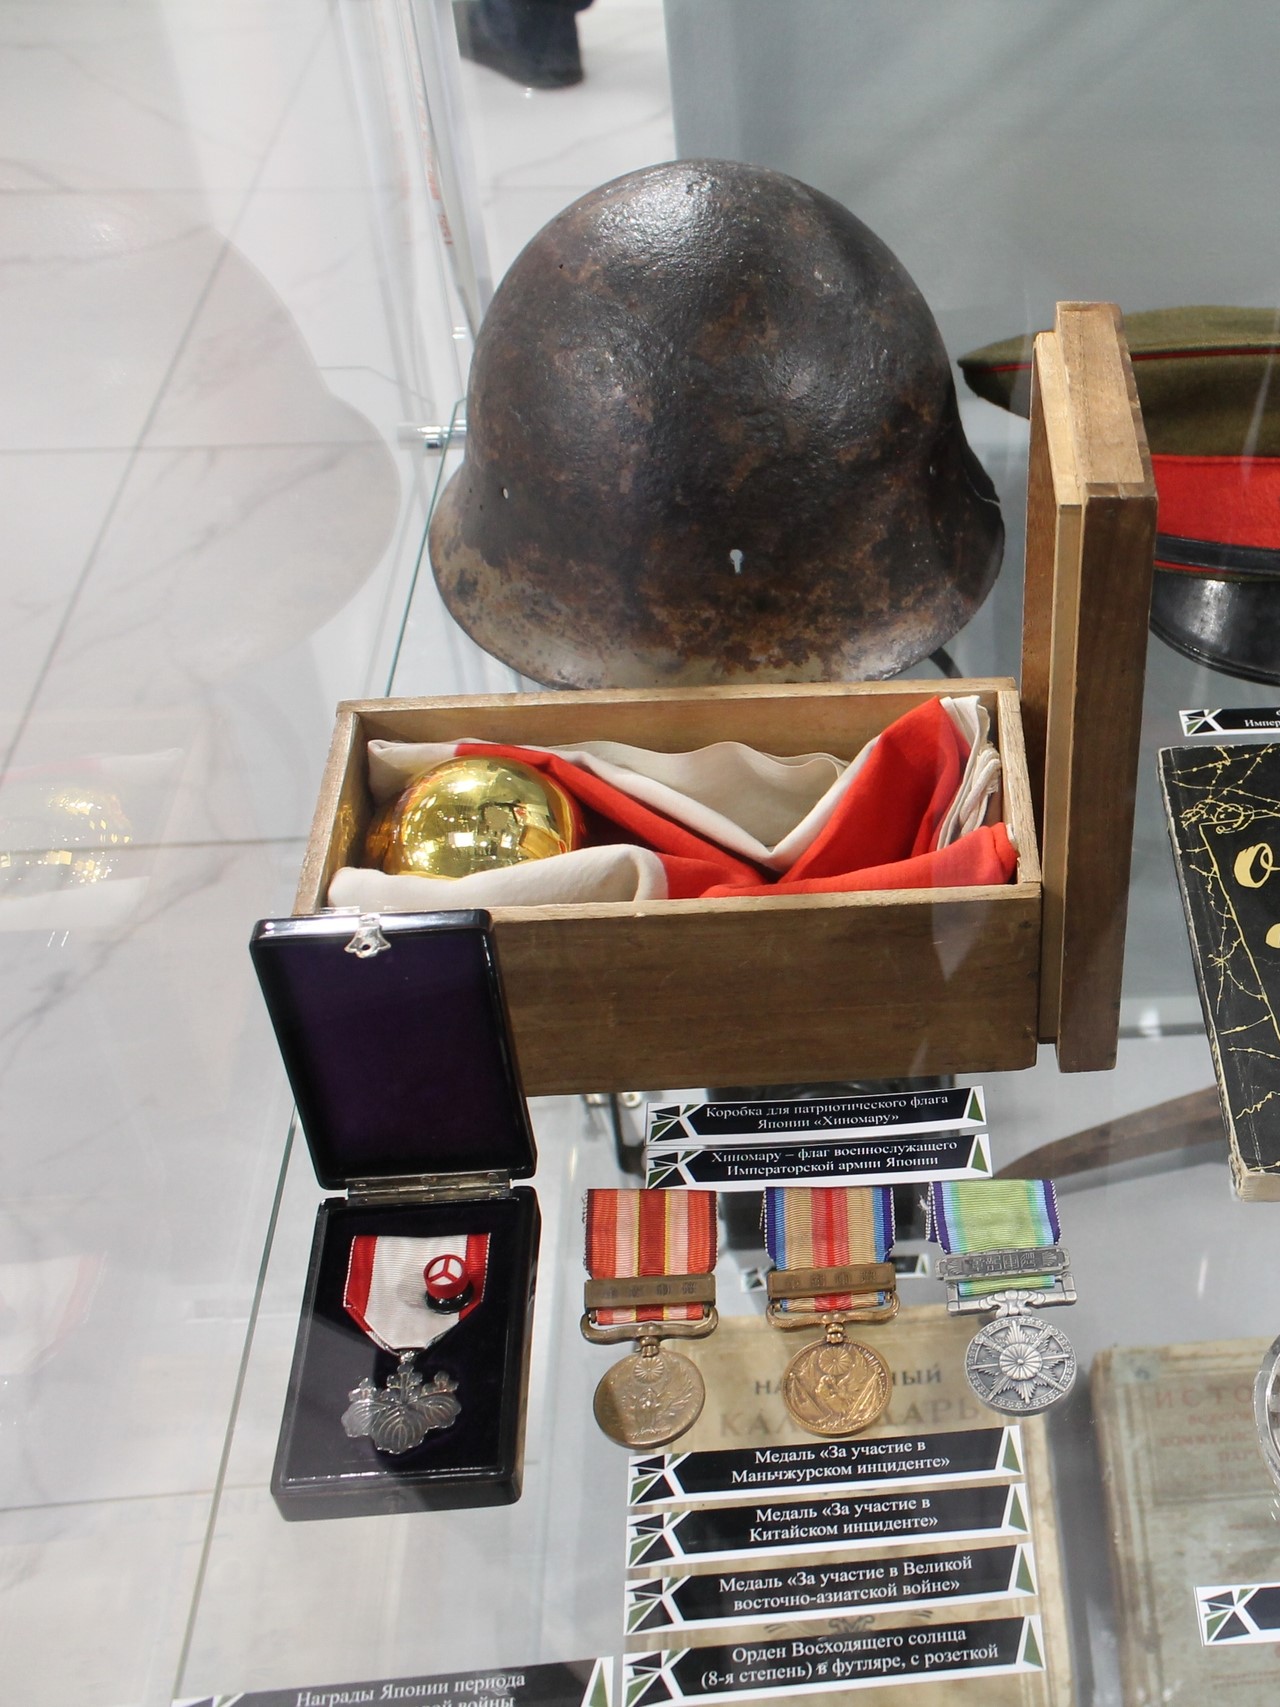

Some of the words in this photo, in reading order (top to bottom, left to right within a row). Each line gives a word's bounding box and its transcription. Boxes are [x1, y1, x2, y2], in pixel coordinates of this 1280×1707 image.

[706, 1105, 764, 1119] Коробка
[766, 1105, 790, 1117] для
[793, 1099, 906, 1116] патриотического
[909, 1095, 949, 1109] флага
[757, 1117, 810, 1129] Японии
[813, 1113, 900, 1129] «Хиномару»
[711, 1150, 782, 1165] Хиномару
[797, 1147, 831, 1161] флаг
[834, 1139, 958, 1157] военнослужащего
[726, 1160, 835, 1177] Императорской
[838, 1159, 882, 1172] армии
[885, 1155, 939, 1168] Японии
[755, 1448, 815, 1465] Медаль
[819, 1445, 848, 1460] «За
[850, 1443, 914, 1459] участие
[917, 1443, 926, 1452] в
[731, 1464, 853, 1485] Маньчжурском
[857, 1455, 951, 1476] инциденте»
[756, 1506, 818, 1523] Медаль
[822, 1503, 851, 1518] «За
[853, 1499, 917, 1516] участие
[921, 1498, 931, 1508] в
[749, 1524, 838, 1543] Китайском
[842, 1513, 938, 1535] инциденте»
[719, 1575, 783, 1593] Медаль
[787, 1571, 816, 1587] «За
[820, 1568, 885, 1586] участие
[889, 1567, 899, 1577] в
[903, 1556, 973, 1576] Великой
[733, 1584, 898, 1612] восточно-азиатской
[902, 1578, 960, 1595] войне»
[732, 1646, 787, 1667] Орден
[791, 1634, 902, 1659] Восходящего
[907, 1628, 967, 1645] солнца
[701, 1670, 734, 1691] (8-я
[739, 1661, 813, 1684] степень)
[831, 1653, 907, 1679] футляре,
[910, 1655, 920, 1665] с
[924, 1644, 999, 1669] розеткой
[296, 1688, 374, 1707] Награды
[379, 1681, 449, 1700] Японии
[454, 1674, 526, 1694] периода
